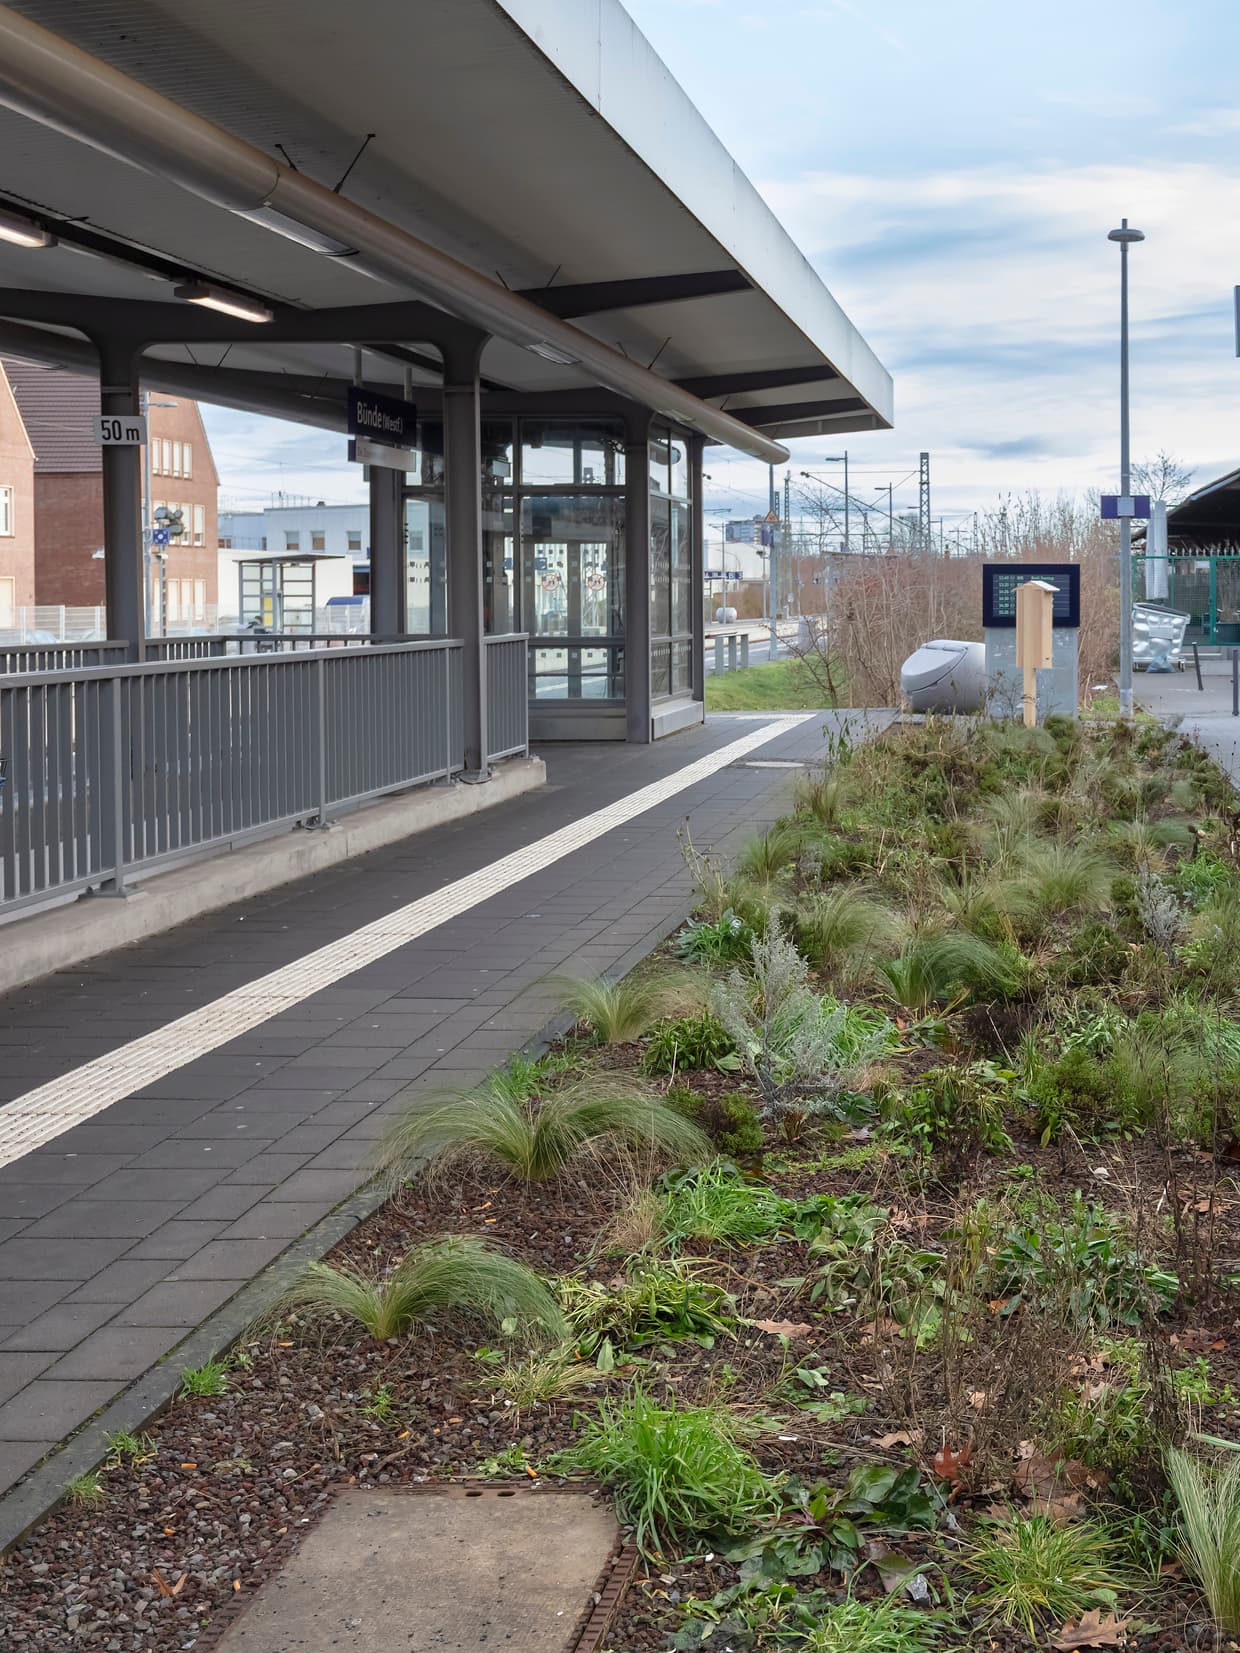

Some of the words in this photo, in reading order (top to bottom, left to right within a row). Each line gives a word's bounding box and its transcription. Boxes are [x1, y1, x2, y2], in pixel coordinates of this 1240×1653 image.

[101, 419, 122, 441] 50
[126, 428, 140, 441] m
[357, 401, 382, 428] Bünde
[383, 412, 403, 435] (Westf.)
